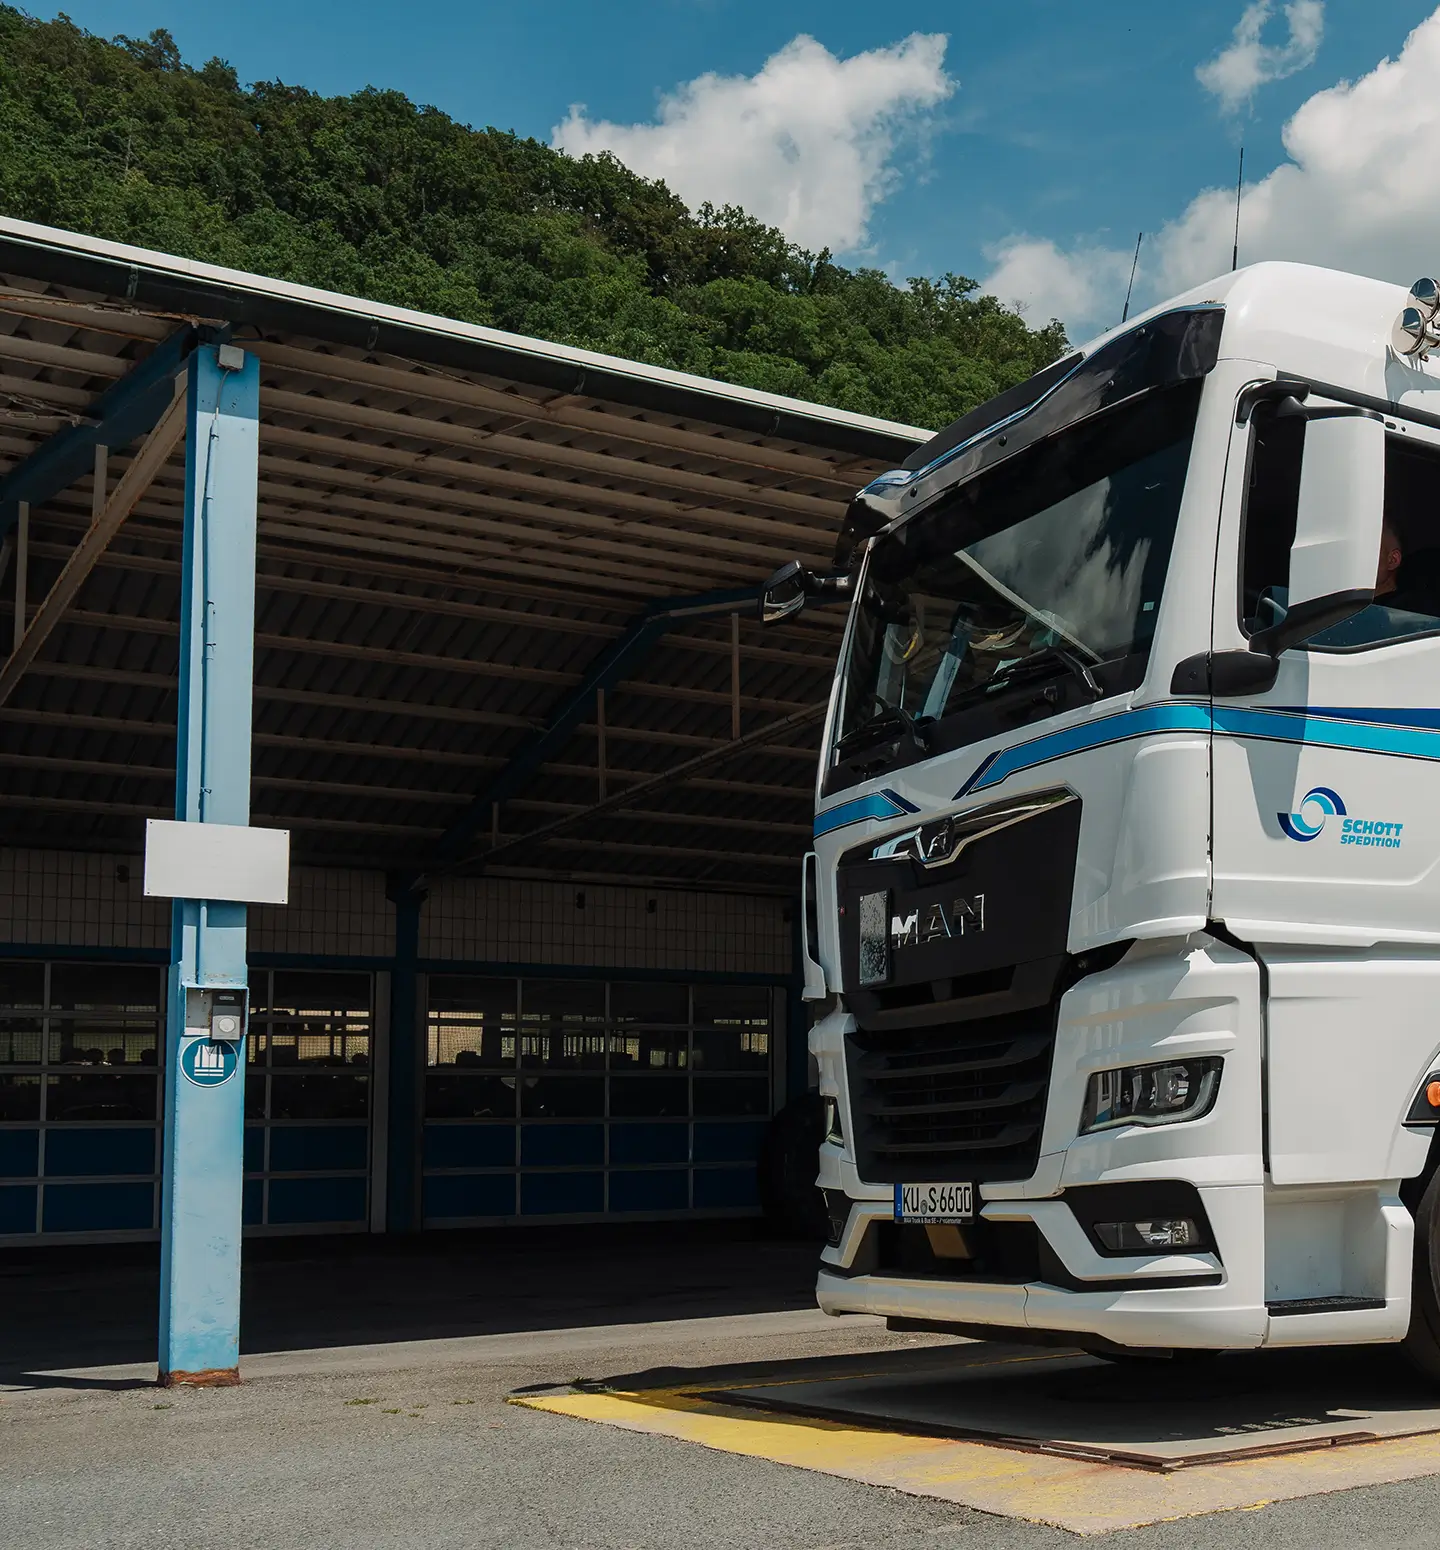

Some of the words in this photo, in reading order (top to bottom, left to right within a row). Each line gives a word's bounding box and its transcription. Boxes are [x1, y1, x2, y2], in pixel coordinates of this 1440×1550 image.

[1342, 819, 1403, 836] SCHOTT
[1340, 834, 1401, 848] SPEDITION
[891, 894, 985, 949] MAN
[903, 1187, 919, 1213] KU
